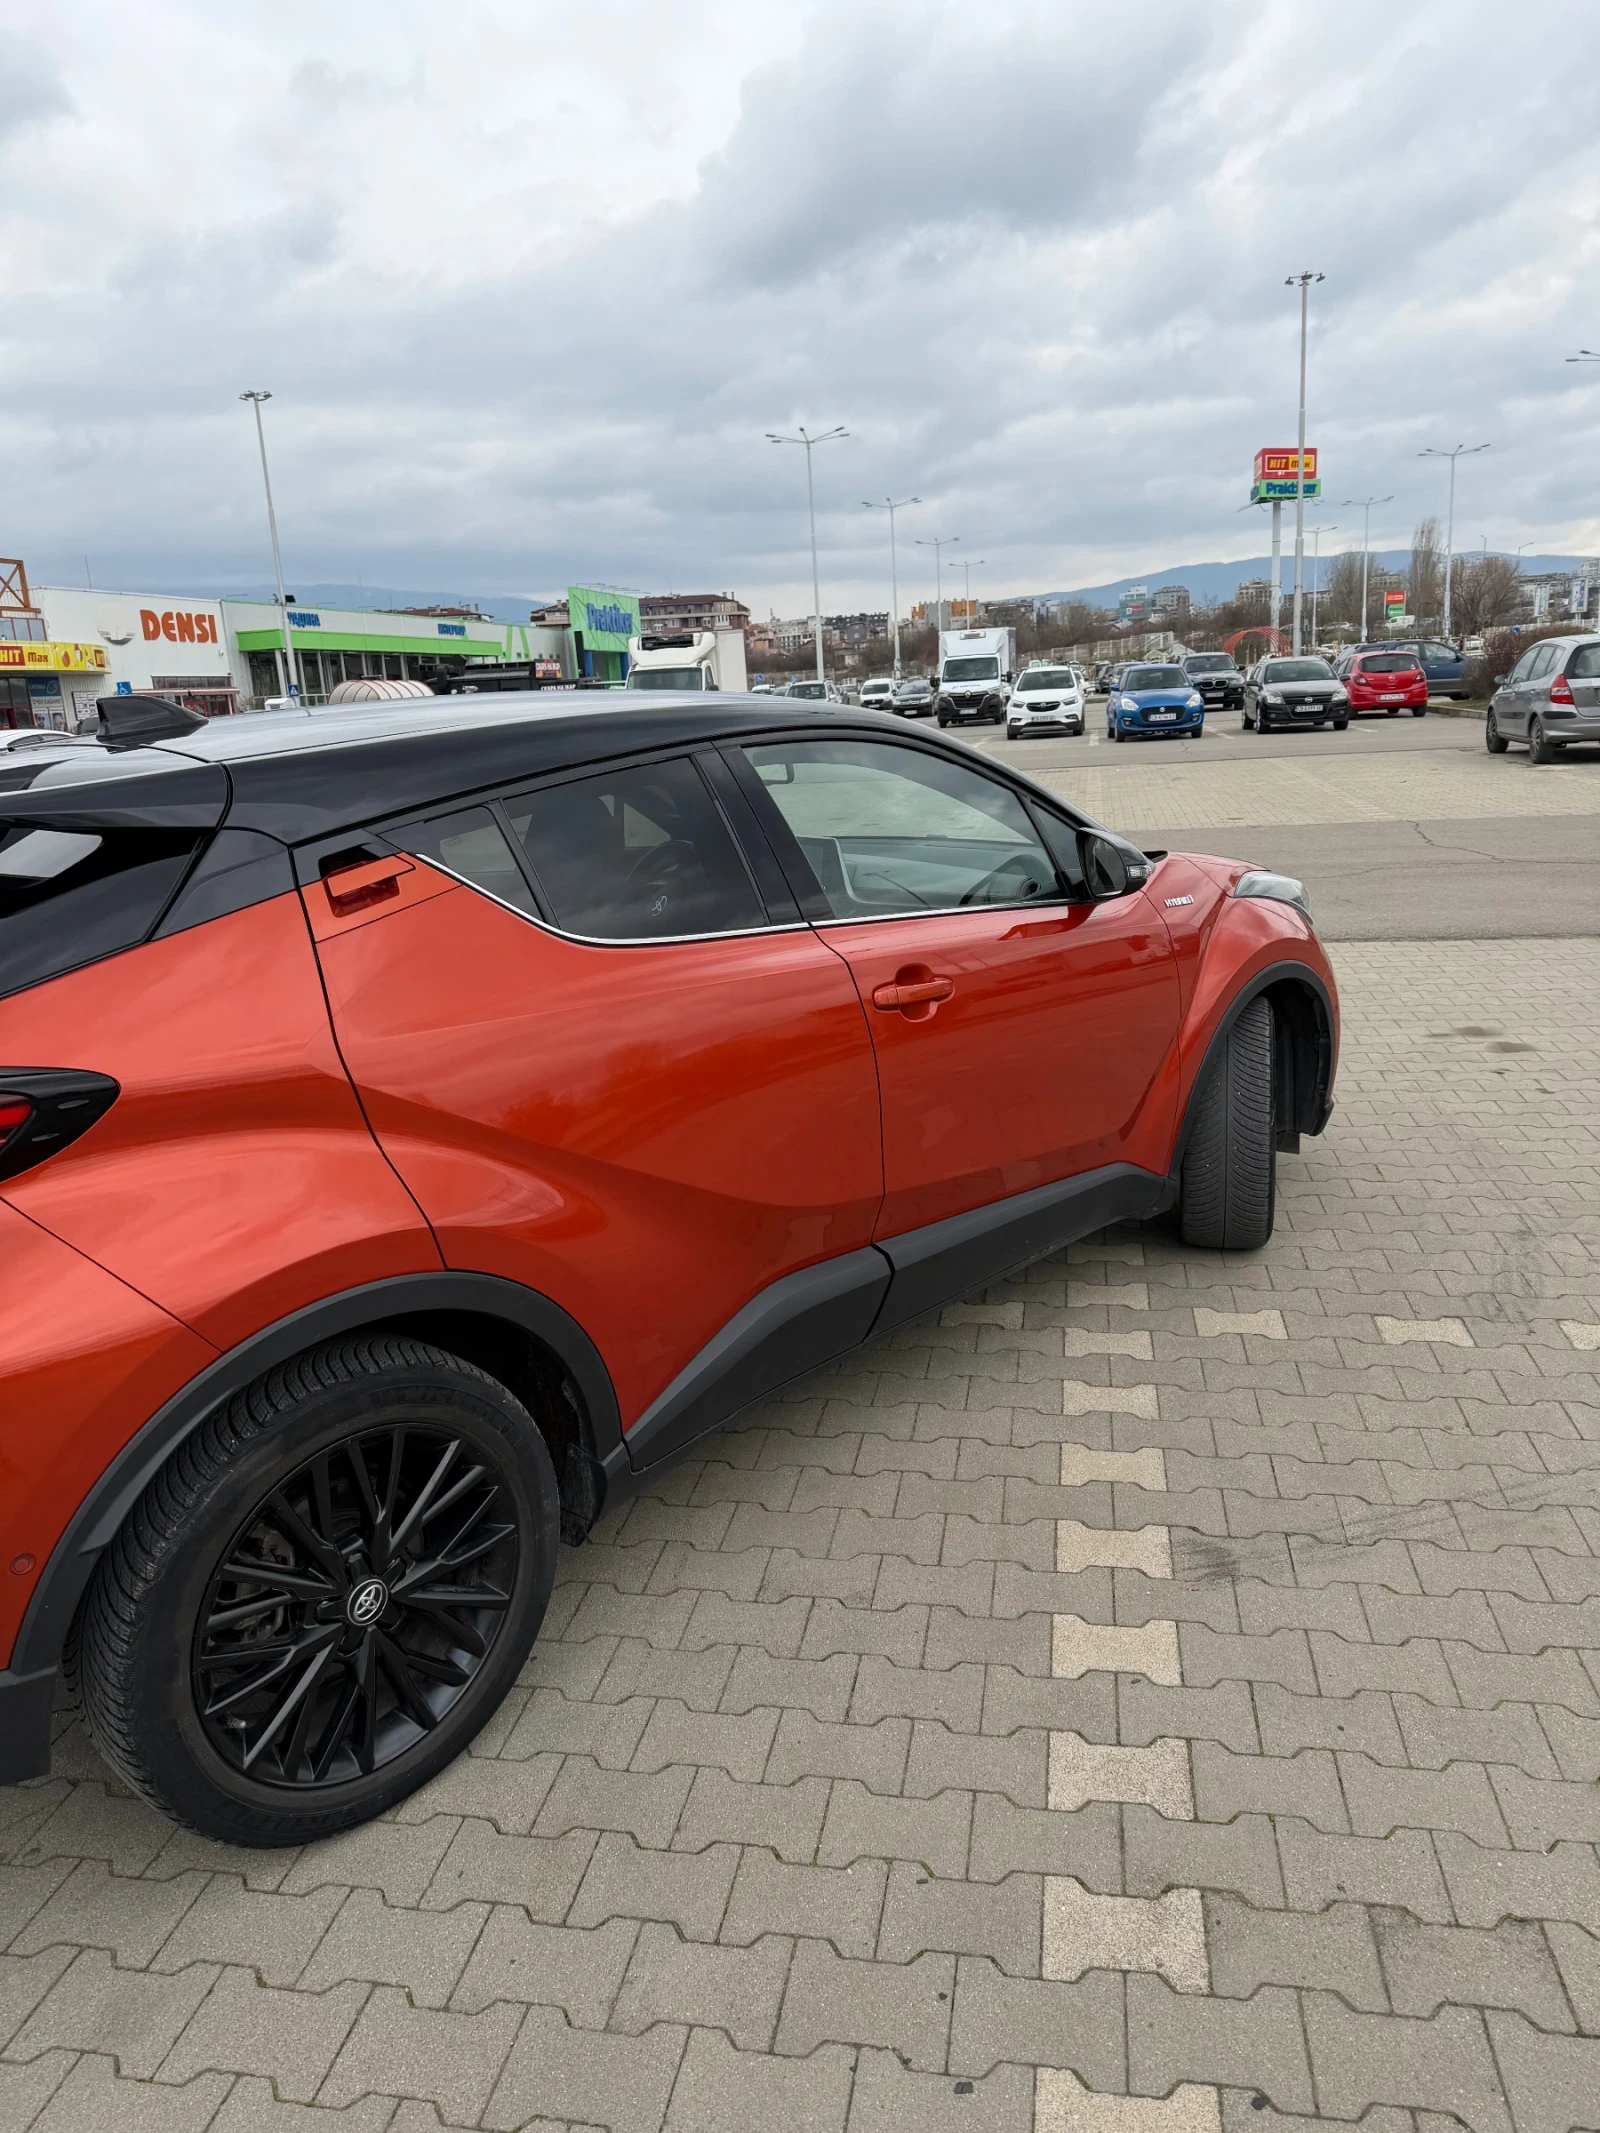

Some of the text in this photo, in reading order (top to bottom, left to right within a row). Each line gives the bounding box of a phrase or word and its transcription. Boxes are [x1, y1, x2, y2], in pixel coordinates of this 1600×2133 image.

[1269, 459, 1310, 468] HIT Mx
[586, 603, 633, 634] Praktiker
[140, 609, 218, 644] DENSI
[28, 652, 48, 662] Max
[1164, 894, 1194, 908] HYBRID
